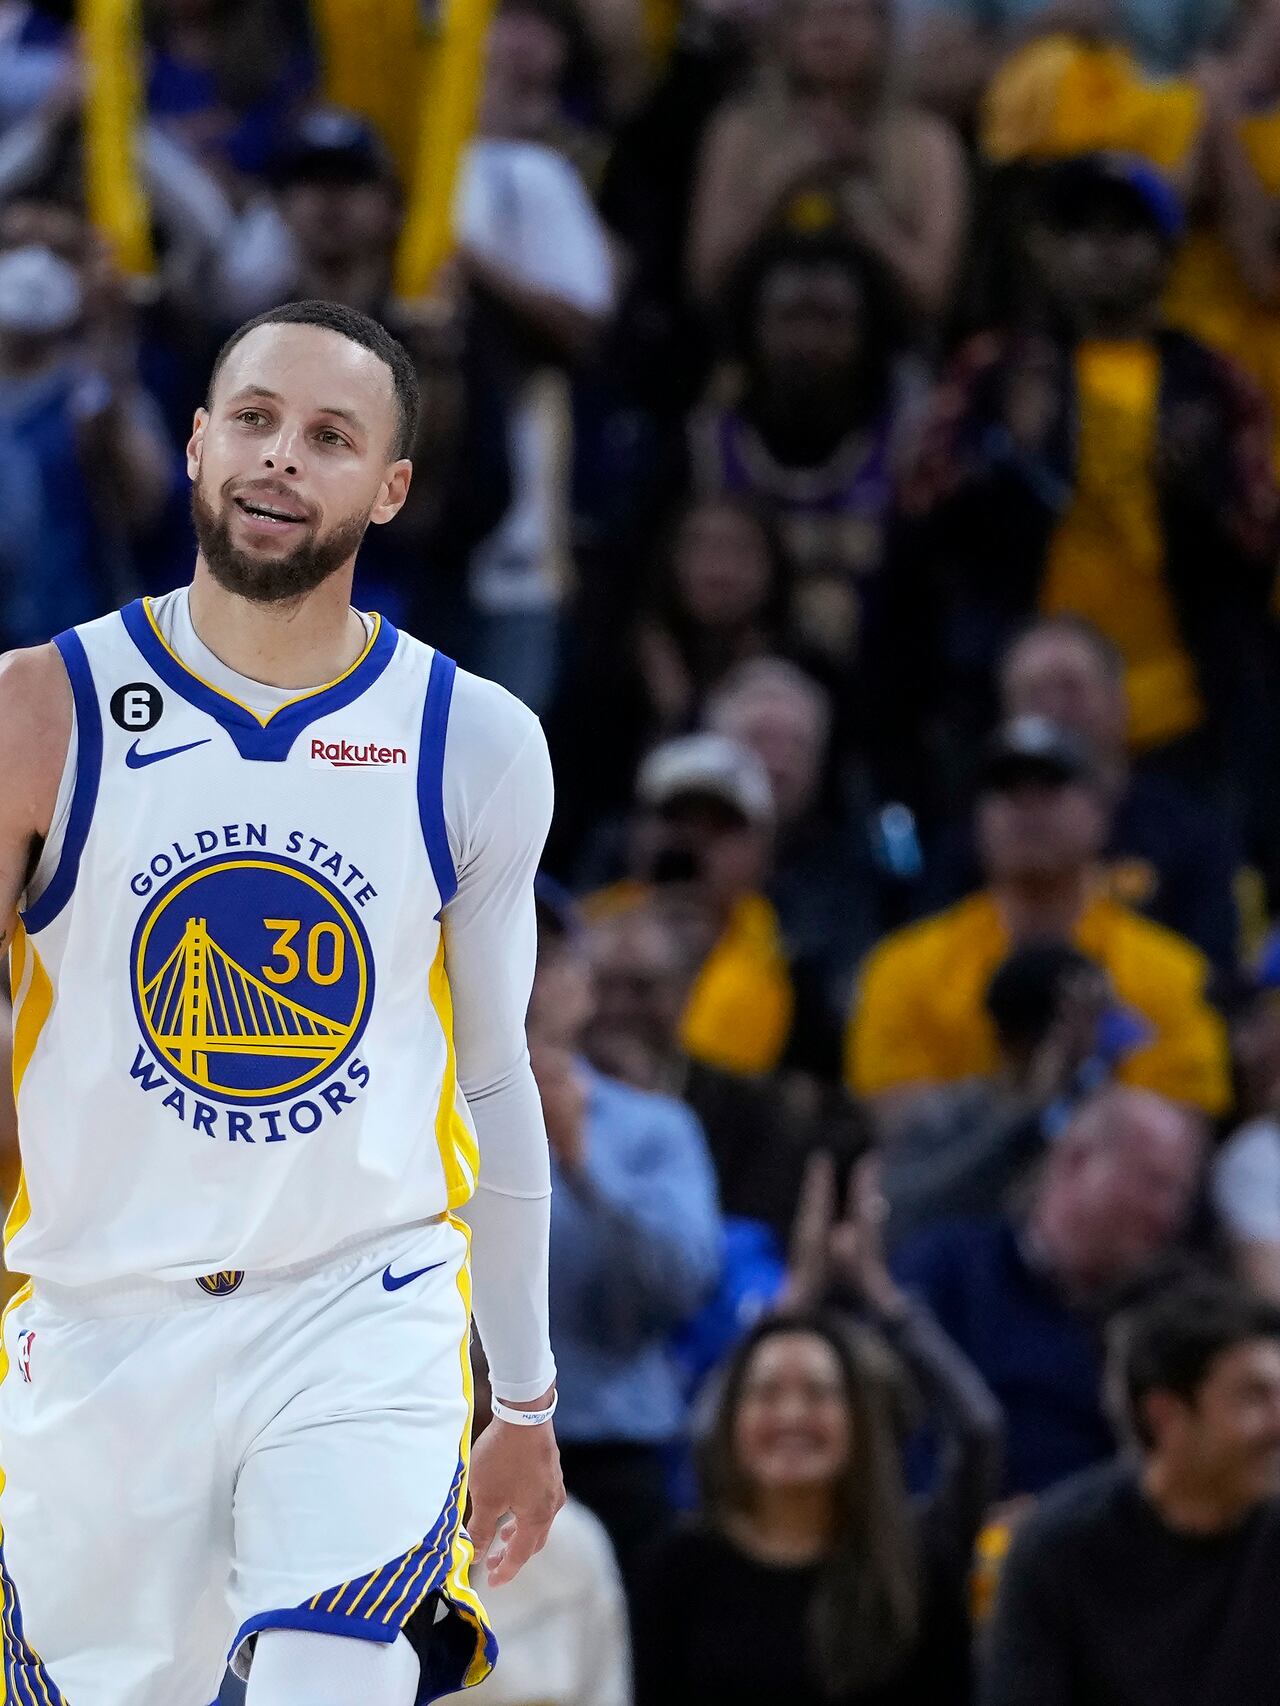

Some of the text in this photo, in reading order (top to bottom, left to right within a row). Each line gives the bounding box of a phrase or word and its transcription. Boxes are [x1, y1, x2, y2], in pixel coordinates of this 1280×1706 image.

[123, 690, 151, 726] 6
[311, 739, 407, 765] Rakuten
[130, 823, 377, 907] GOLDEN STATE
[261, 918, 345, 986] 30
[129, 1044, 370, 1143] WARRIORS
